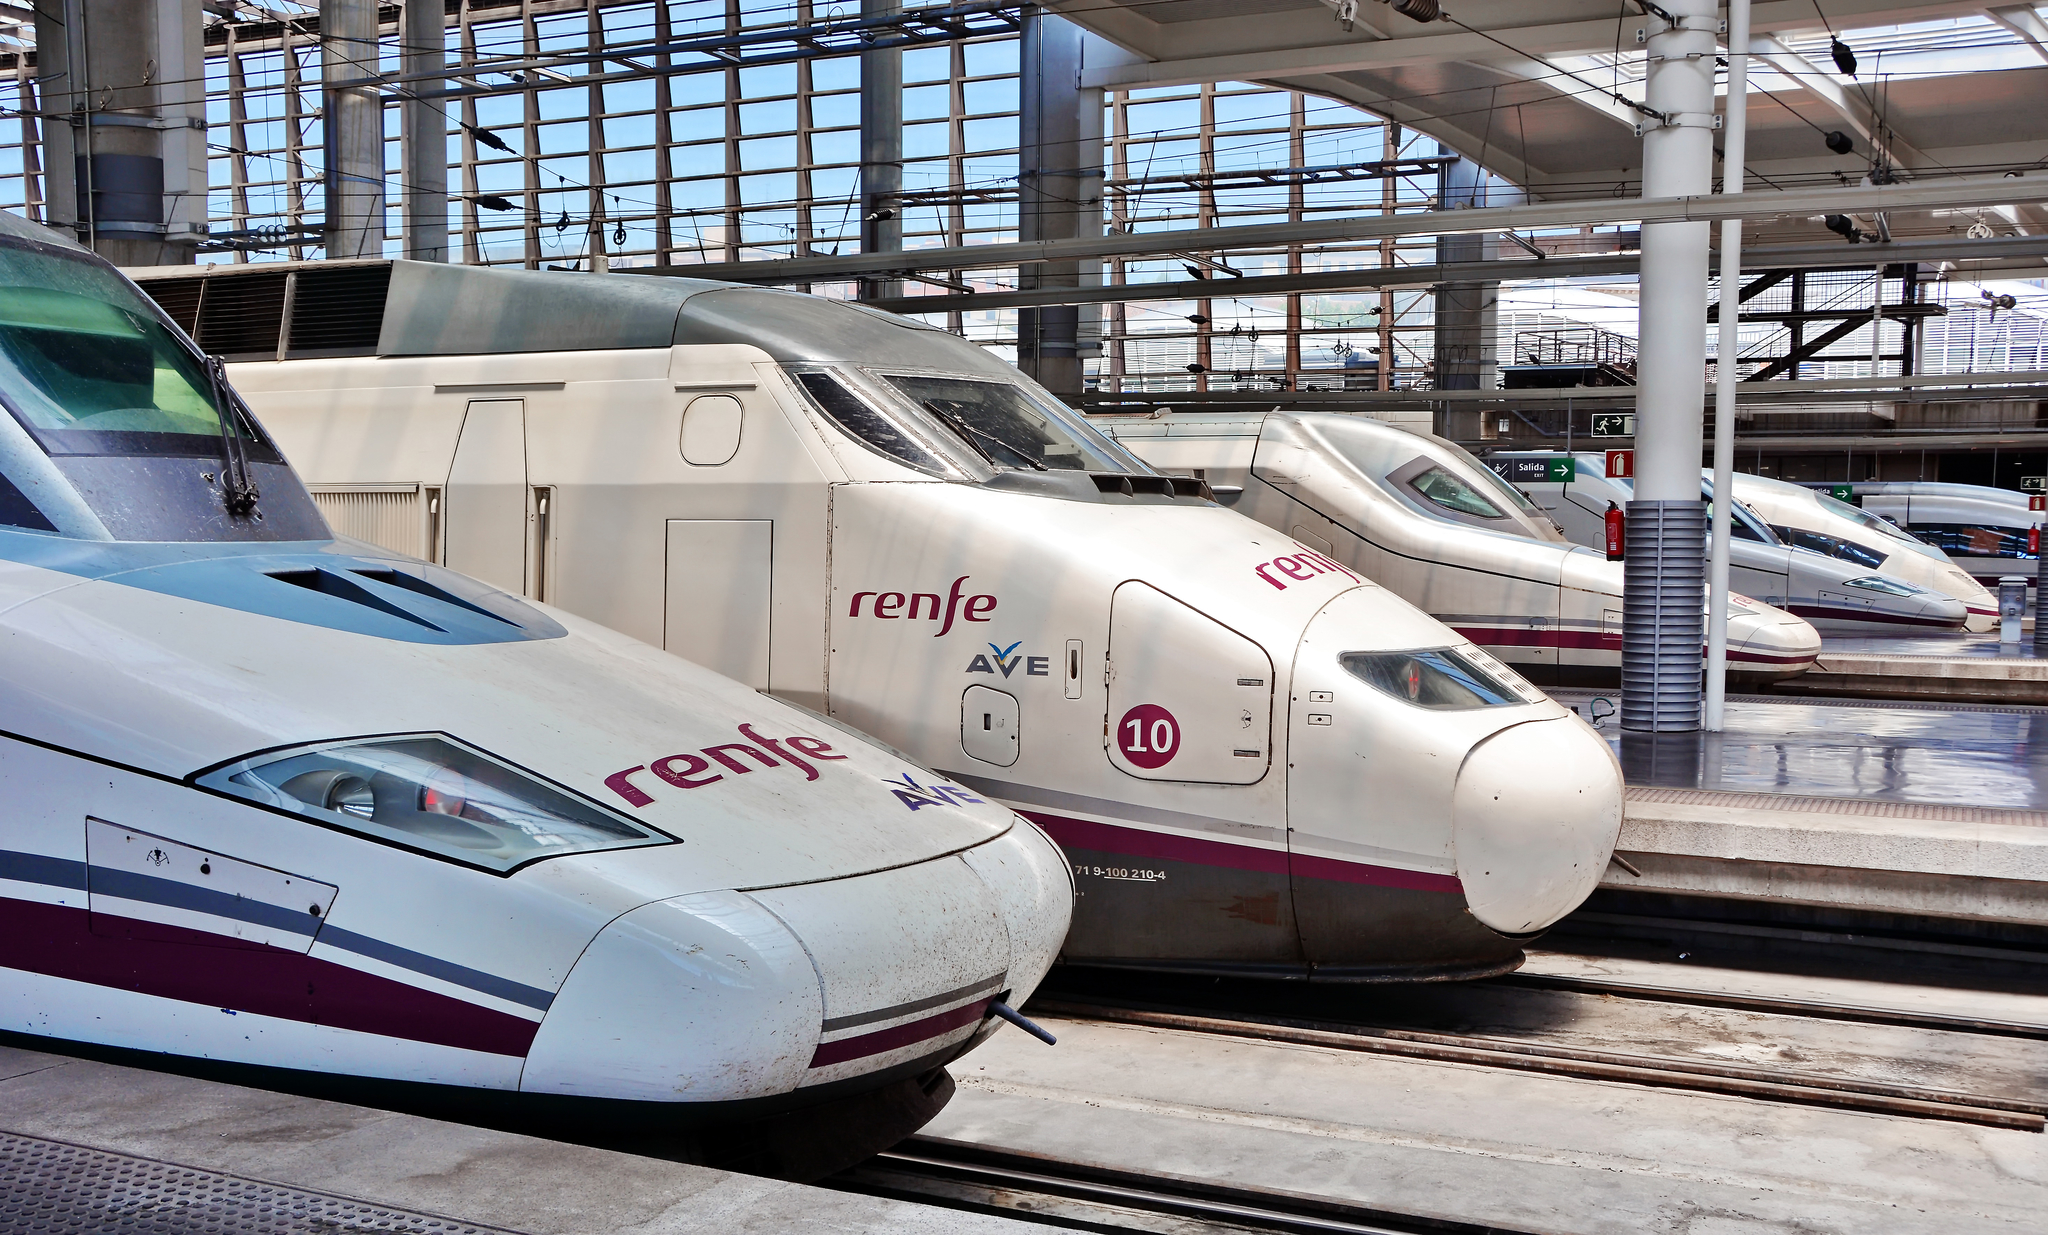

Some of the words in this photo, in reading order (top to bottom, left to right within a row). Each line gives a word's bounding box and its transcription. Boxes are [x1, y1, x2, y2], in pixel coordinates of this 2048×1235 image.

[1518, 463, 1545, 471] Salida
[849, 575, 998, 638] renfe
[965, 654, 1049, 680] AVE
[1126, 718, 1174, 754] 10
[603, 723, 849, 809] renfe
[889, 785, 987, 812] AVE
[1075, 865, 1089, 876] 71
[1093, 866, 1128, 878] 9-100
[1131, 869, 1166, 880] 210-4
